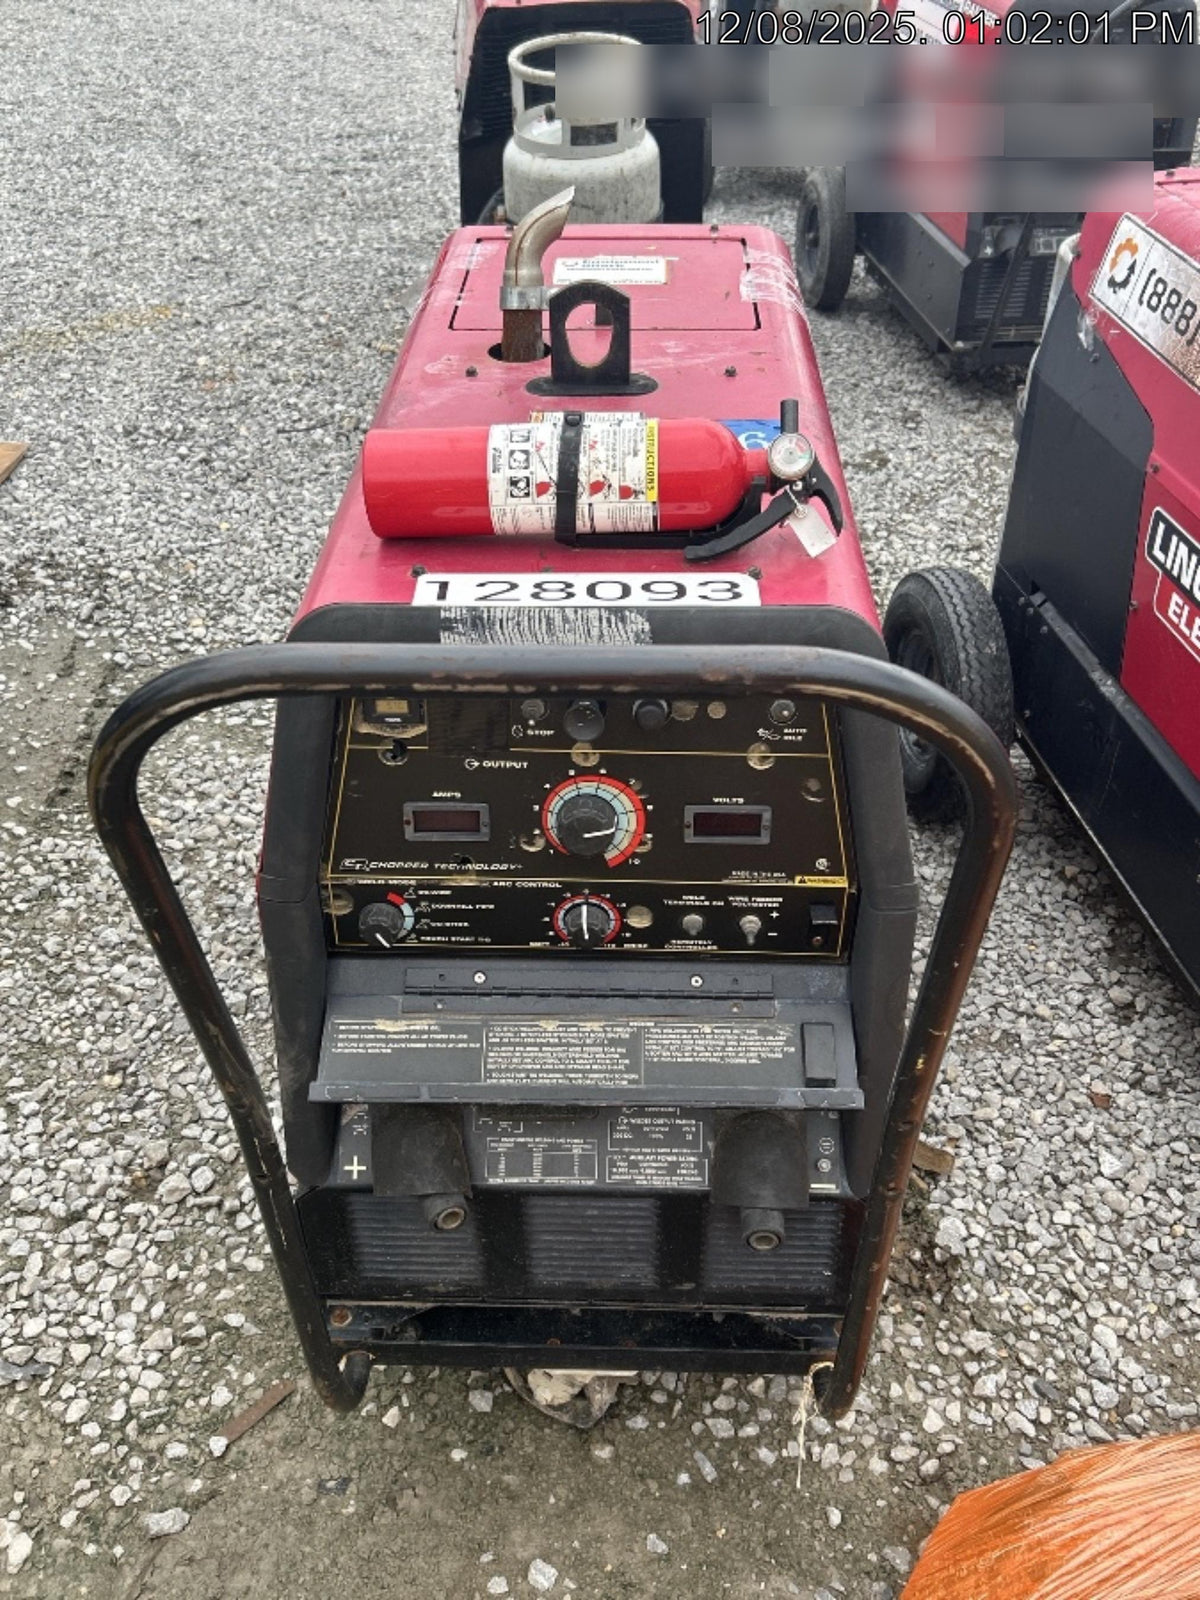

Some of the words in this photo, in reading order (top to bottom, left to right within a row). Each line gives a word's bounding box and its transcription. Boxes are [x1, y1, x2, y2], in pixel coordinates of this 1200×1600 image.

[426, 580, 743, 602] 128093
[482, 760, 529, 769] OUTPUT
[432, 791, 462, 799] AMPS
